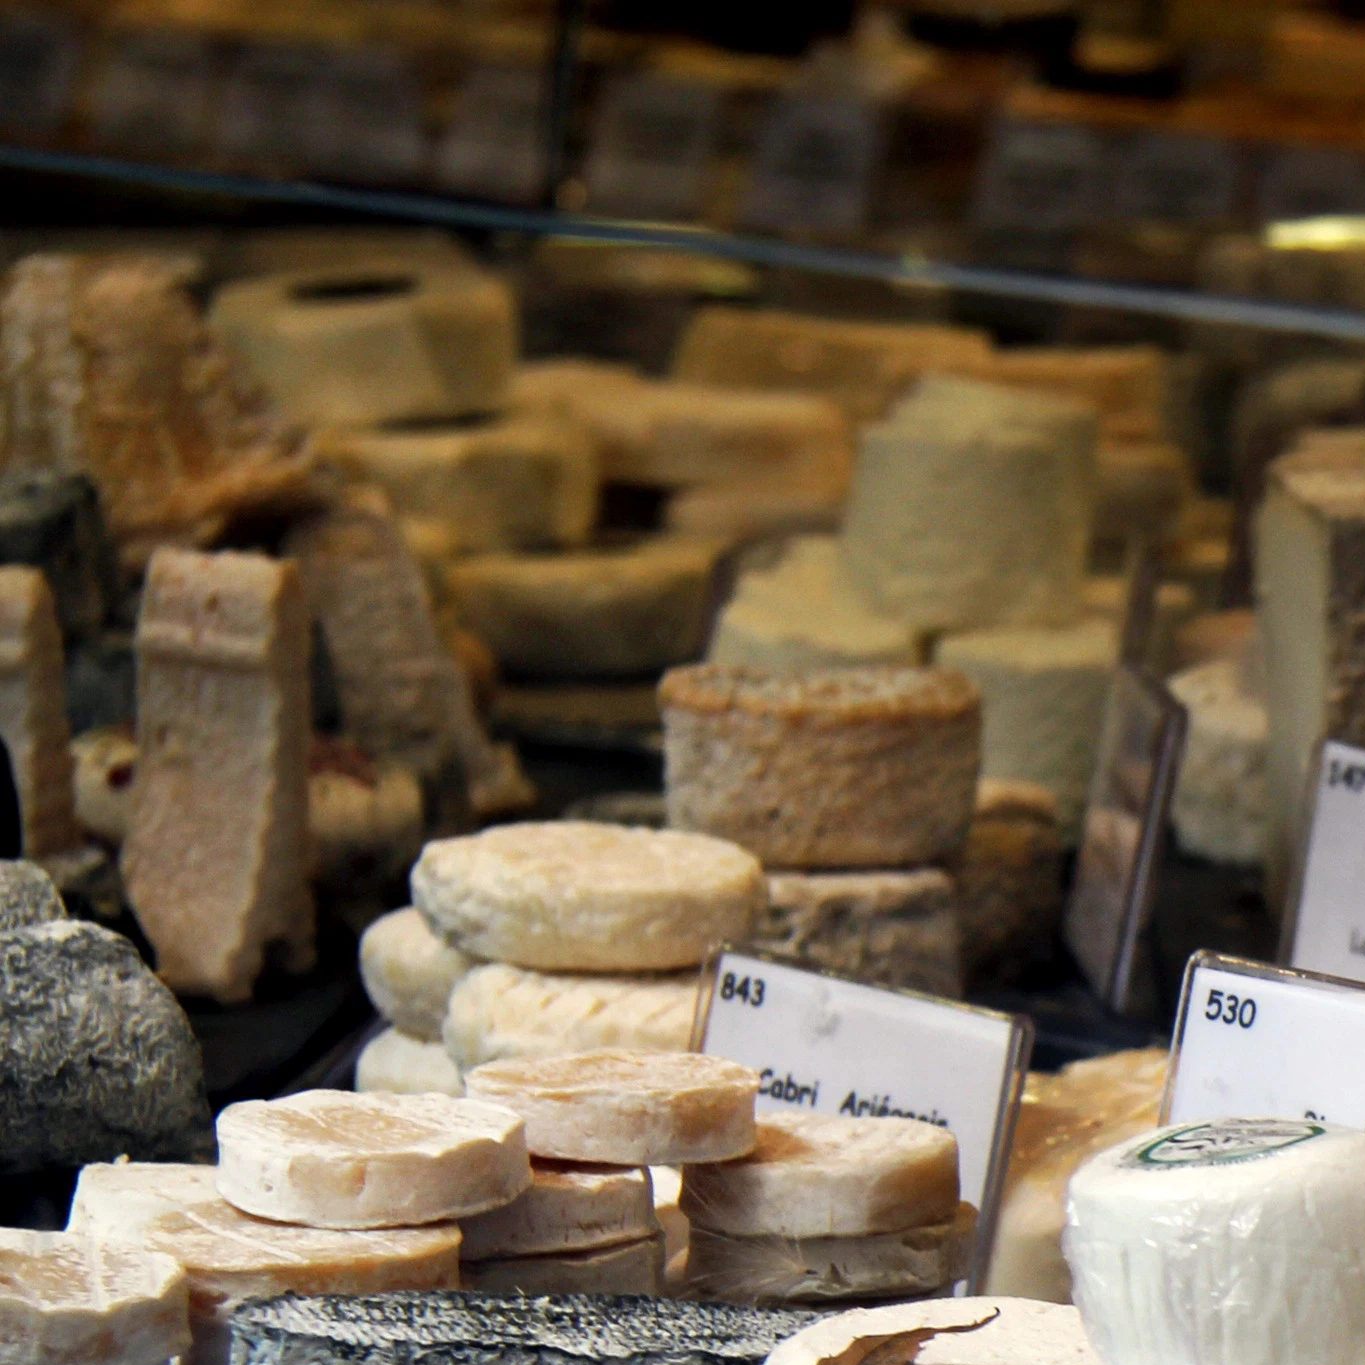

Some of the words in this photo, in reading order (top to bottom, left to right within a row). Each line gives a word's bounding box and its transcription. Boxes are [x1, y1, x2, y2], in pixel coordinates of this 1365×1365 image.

[720, 972, 766, 1008] 843
[1204, 989, 1256, 1029] 530
[758, 1067, 820, 1107] Cabri
